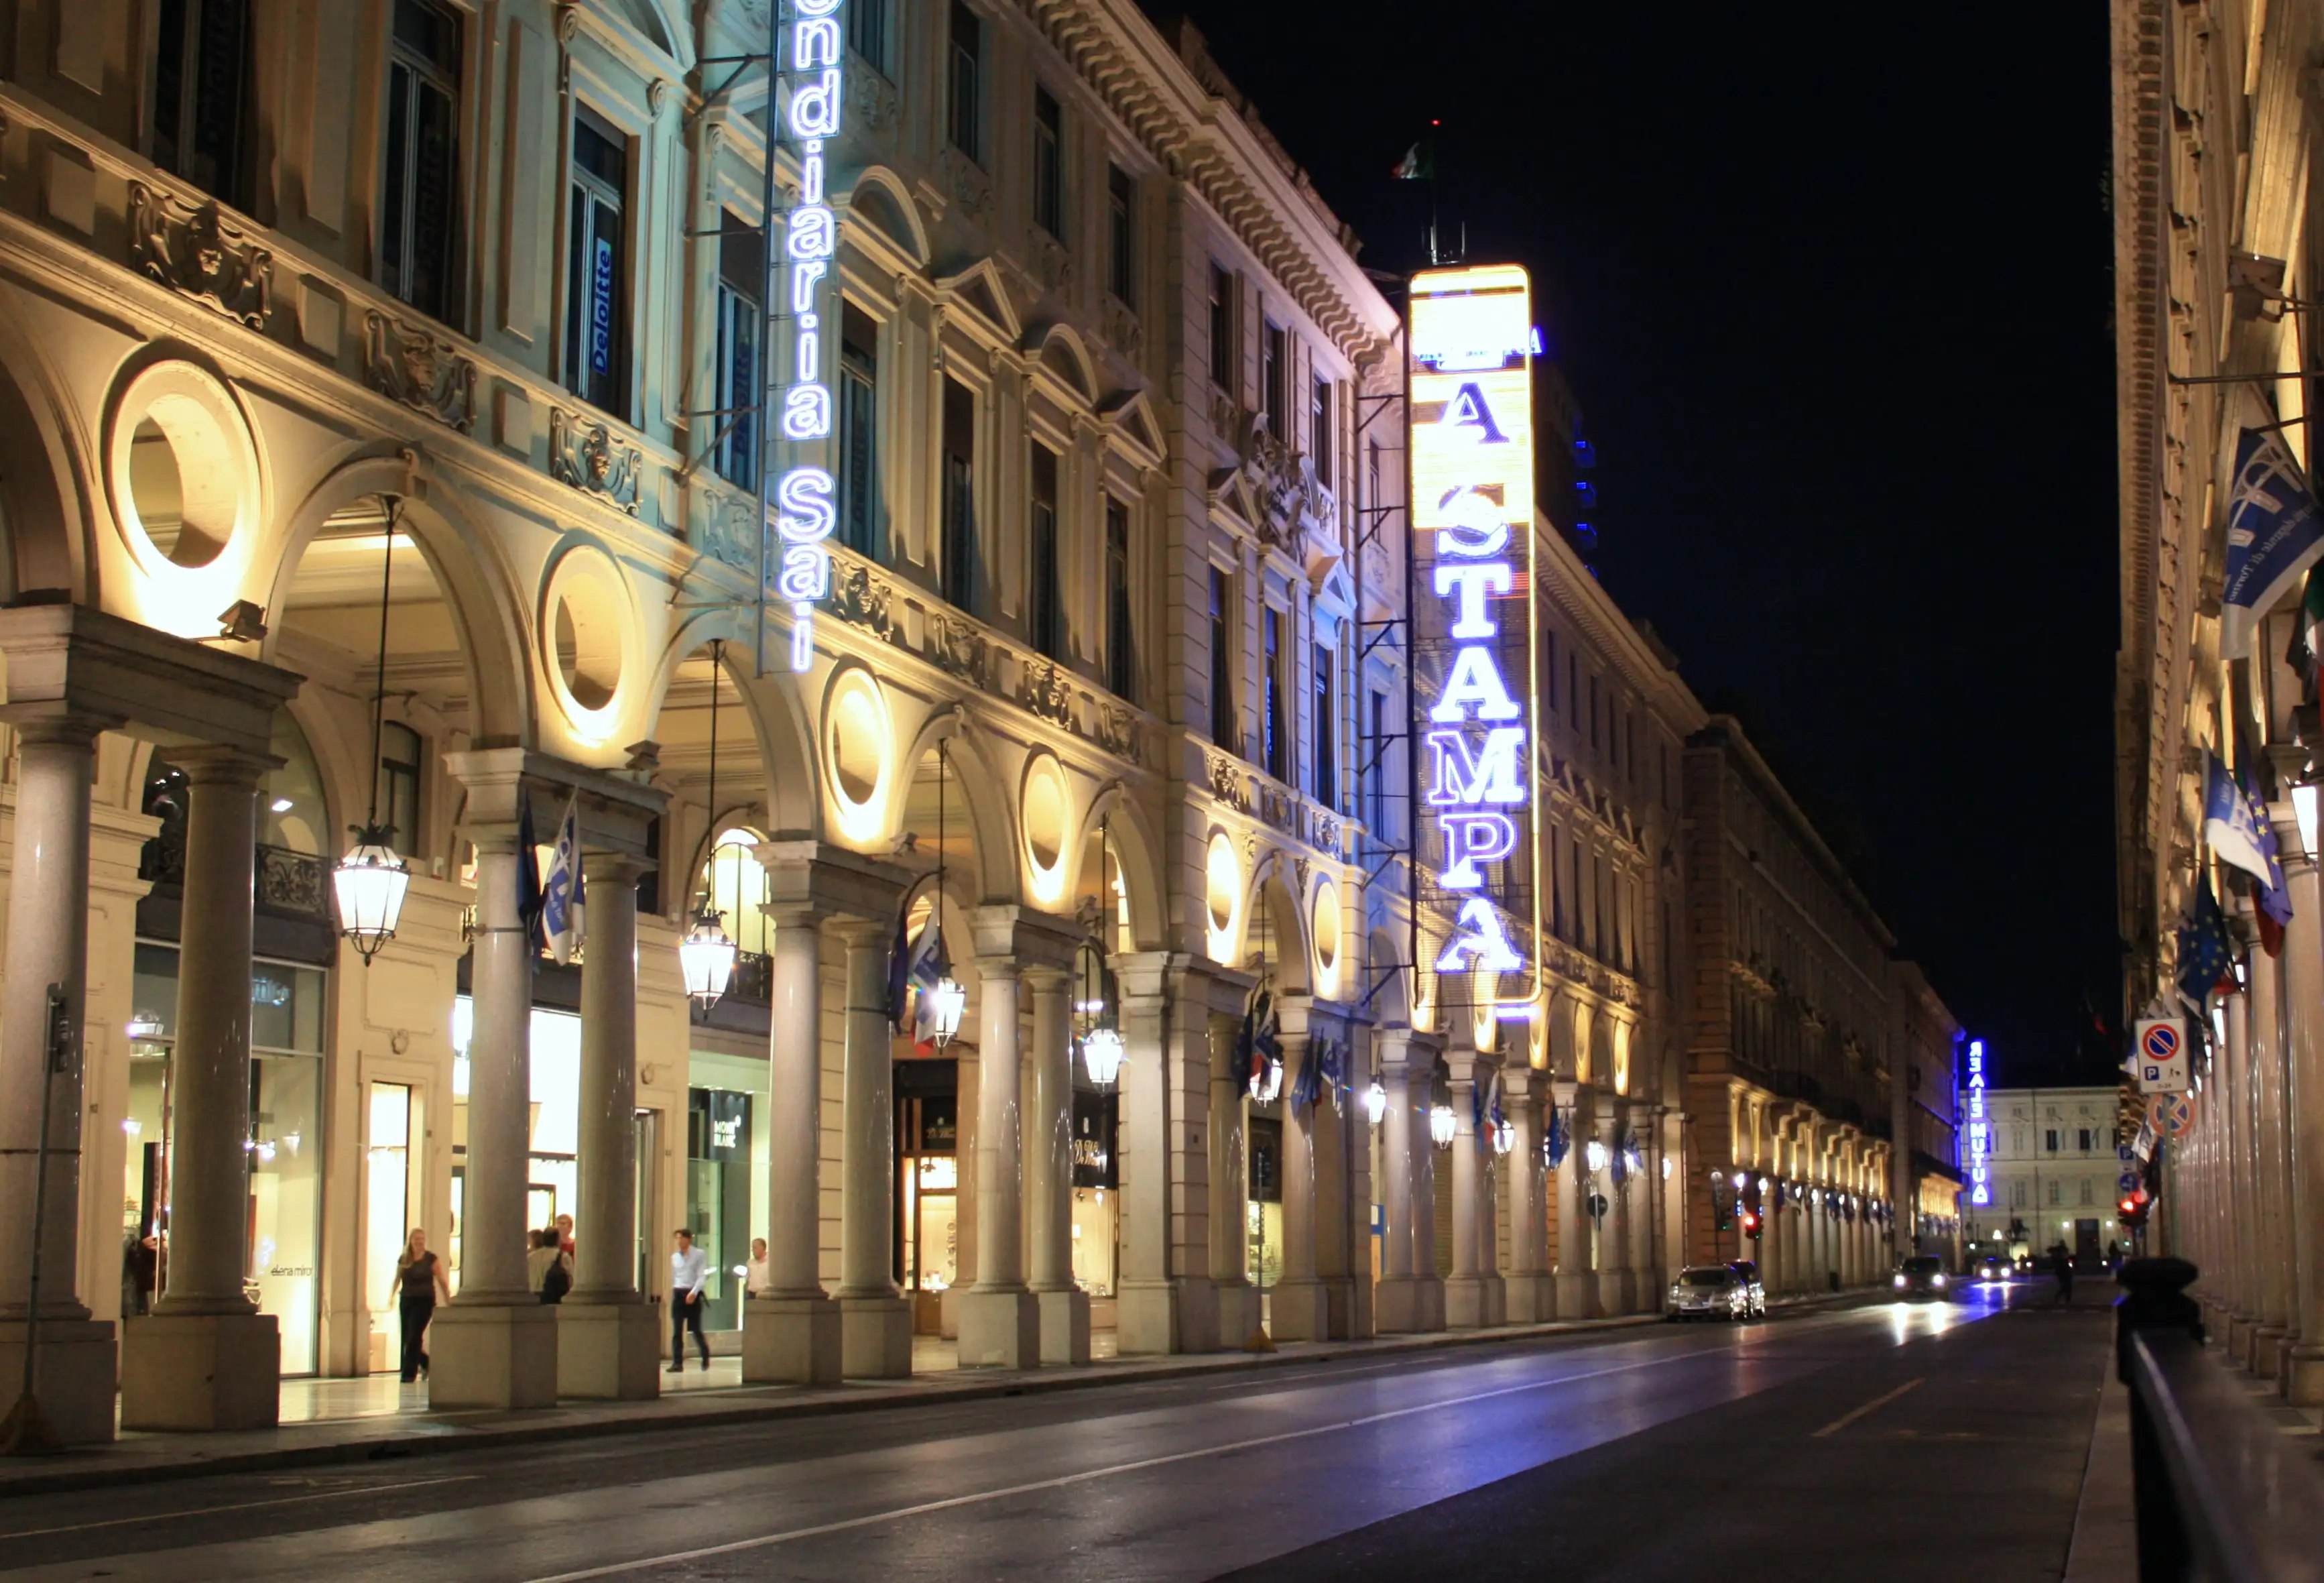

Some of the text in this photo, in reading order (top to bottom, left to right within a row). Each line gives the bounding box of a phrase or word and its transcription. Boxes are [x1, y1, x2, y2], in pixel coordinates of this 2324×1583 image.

[593, 249, 611, 374] Deloitte
[778, 468, 837, 672] Sai
[1428, 483, 1526, 972] STAMPA
